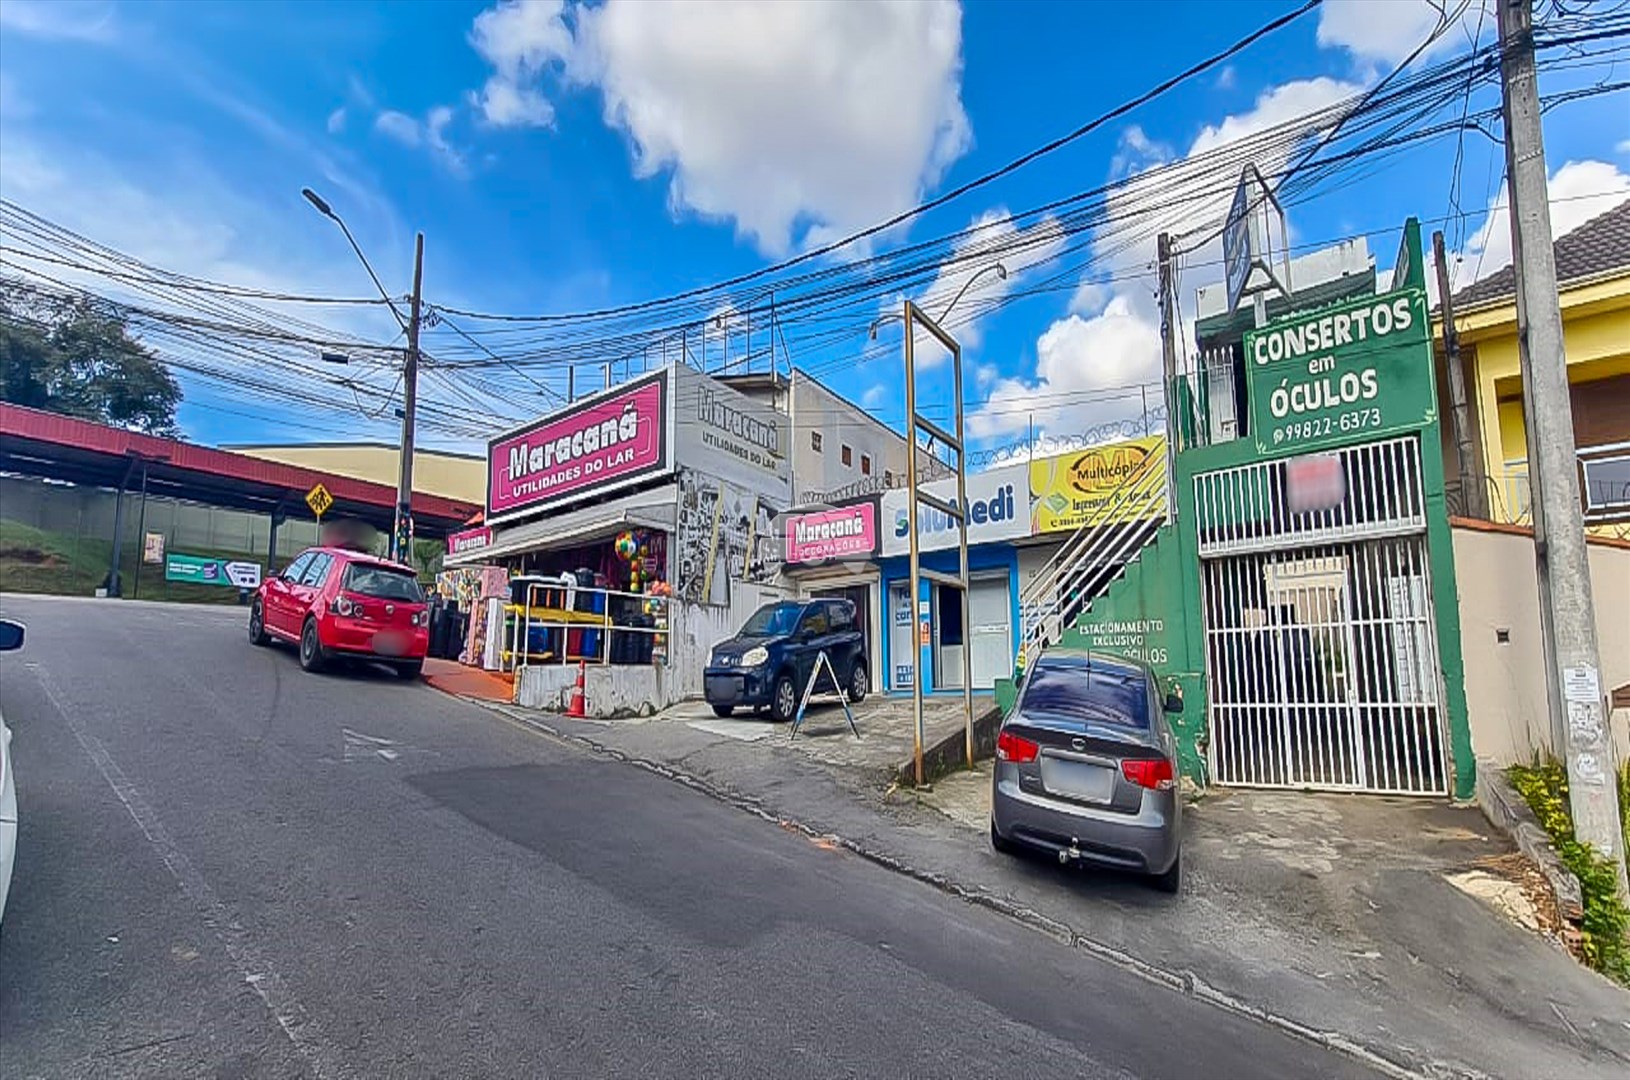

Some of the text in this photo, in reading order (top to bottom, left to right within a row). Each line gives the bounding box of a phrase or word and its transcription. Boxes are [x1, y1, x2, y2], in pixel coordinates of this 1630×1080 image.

[1255, 298, 1412, 365] CONSERTOS
[1308, 355, 1336, 374] em
[1270, 369, 1379, 418] ÓCULOS
[1285, 408, 1382, 441] 99822-6373
[703, 431, 777, 470] UTILIDADES DO LAR
[513, 448, 634, 498] UTILIDADES DO LAR
[1080, 620, 1163, 635] ESTACIONAMENTO
[1093, 635, 1143, 646] EXCLUSIVO
